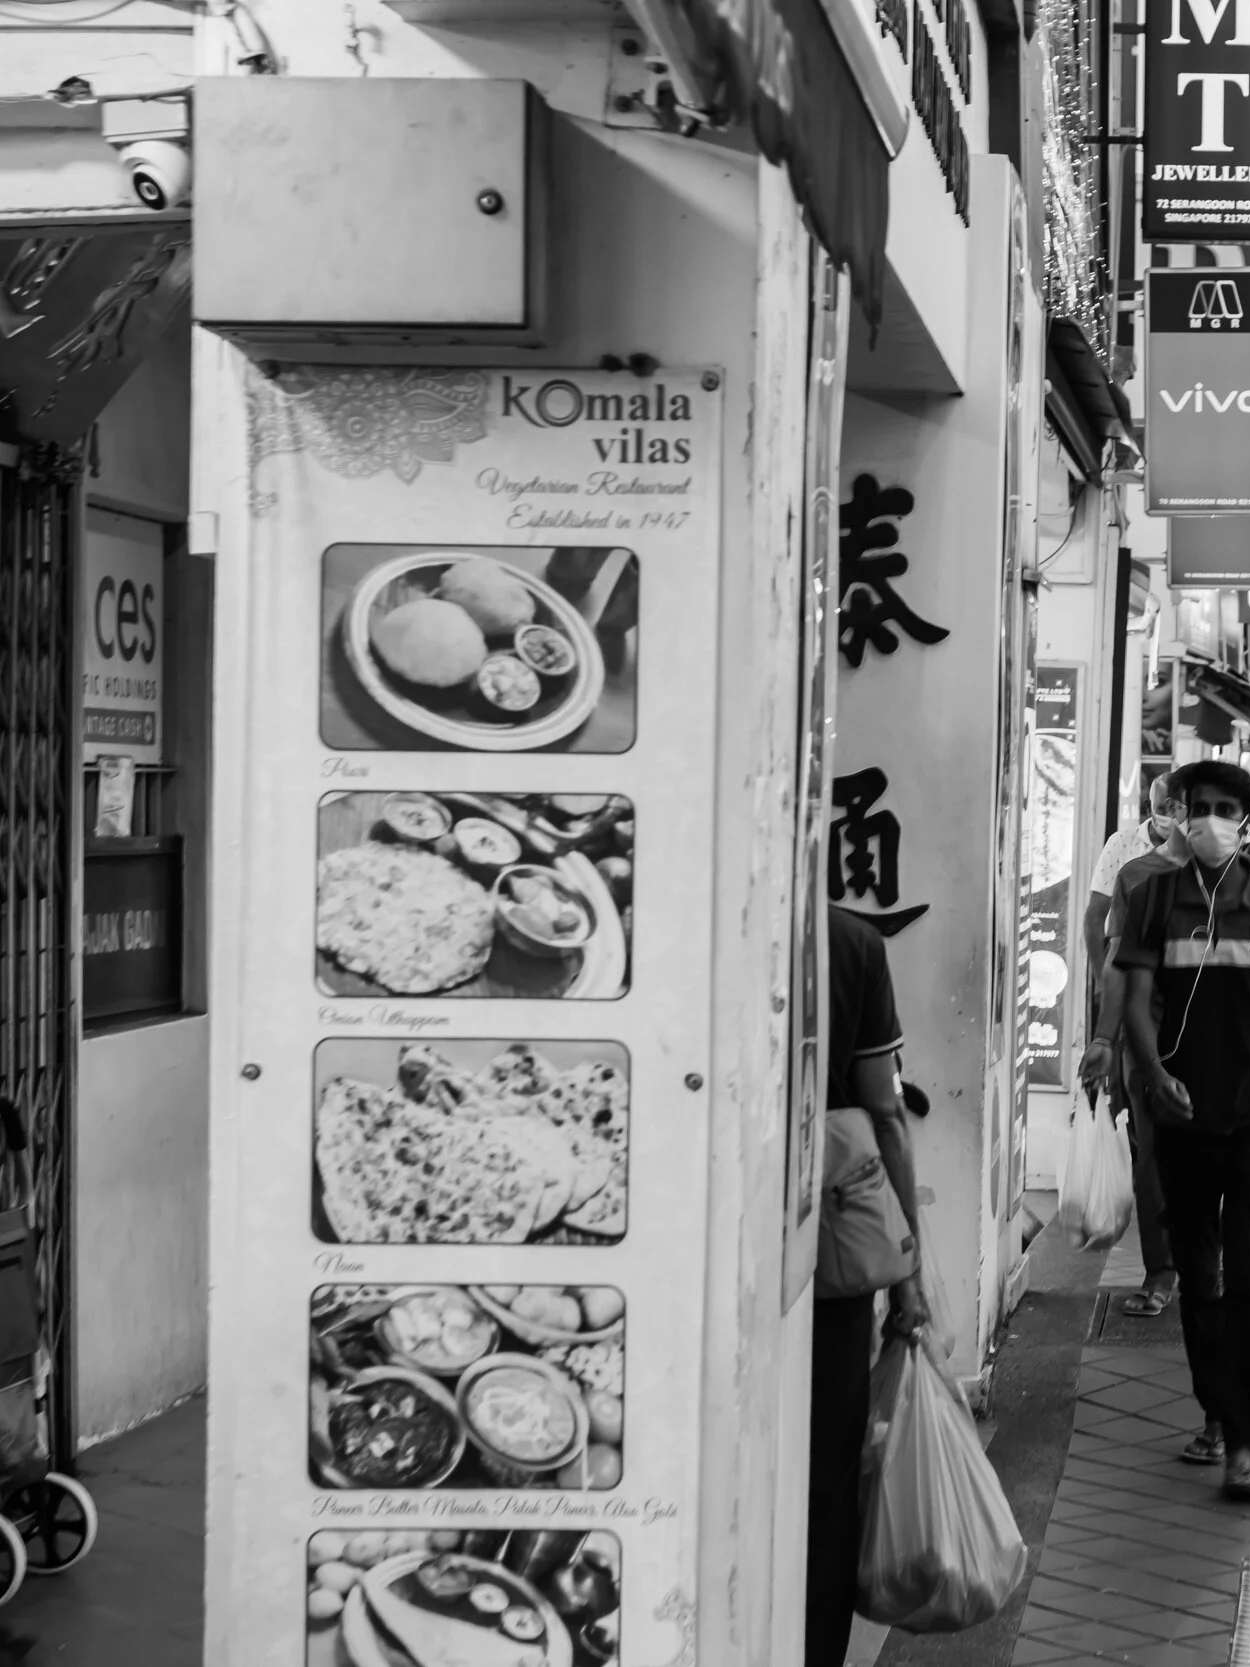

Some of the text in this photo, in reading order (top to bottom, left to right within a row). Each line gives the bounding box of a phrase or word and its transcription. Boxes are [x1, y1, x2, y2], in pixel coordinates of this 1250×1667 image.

[1156, 199, 1171, 209] 72
[1170, 199, 1235, 211] SERANGOON
[1164, 213, 1222, 224] SINGAPORE
[592, 428, 691, 464] vilas
[475, 467, 692, 501] Vegetarian Restaurant
[506, 503, 614, 529] Established
[616, 514, 630, 529] in
[313, 1252, 364, 1274] Naan
